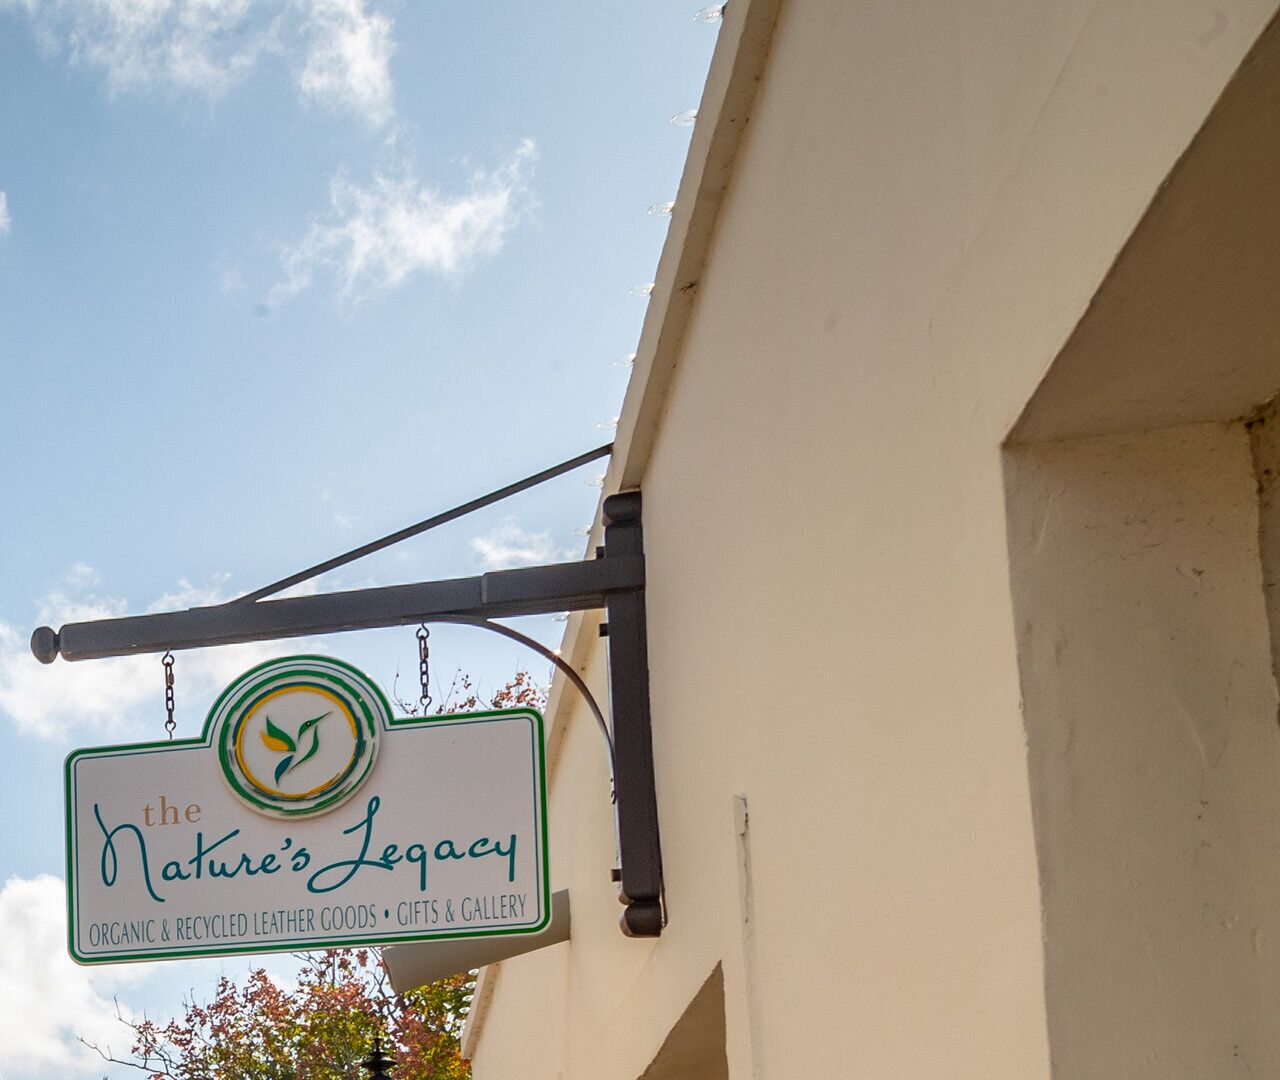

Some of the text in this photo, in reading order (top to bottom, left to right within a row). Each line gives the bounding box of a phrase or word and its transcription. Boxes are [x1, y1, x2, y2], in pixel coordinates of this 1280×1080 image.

[142, 796, 202, 826] the
[94, 796, 517, 902] Nature's Legacy
[89, 894, 527, 947] ORGANIC & RECYCLED LEATHER GOODS GIFTS & GALLERY
